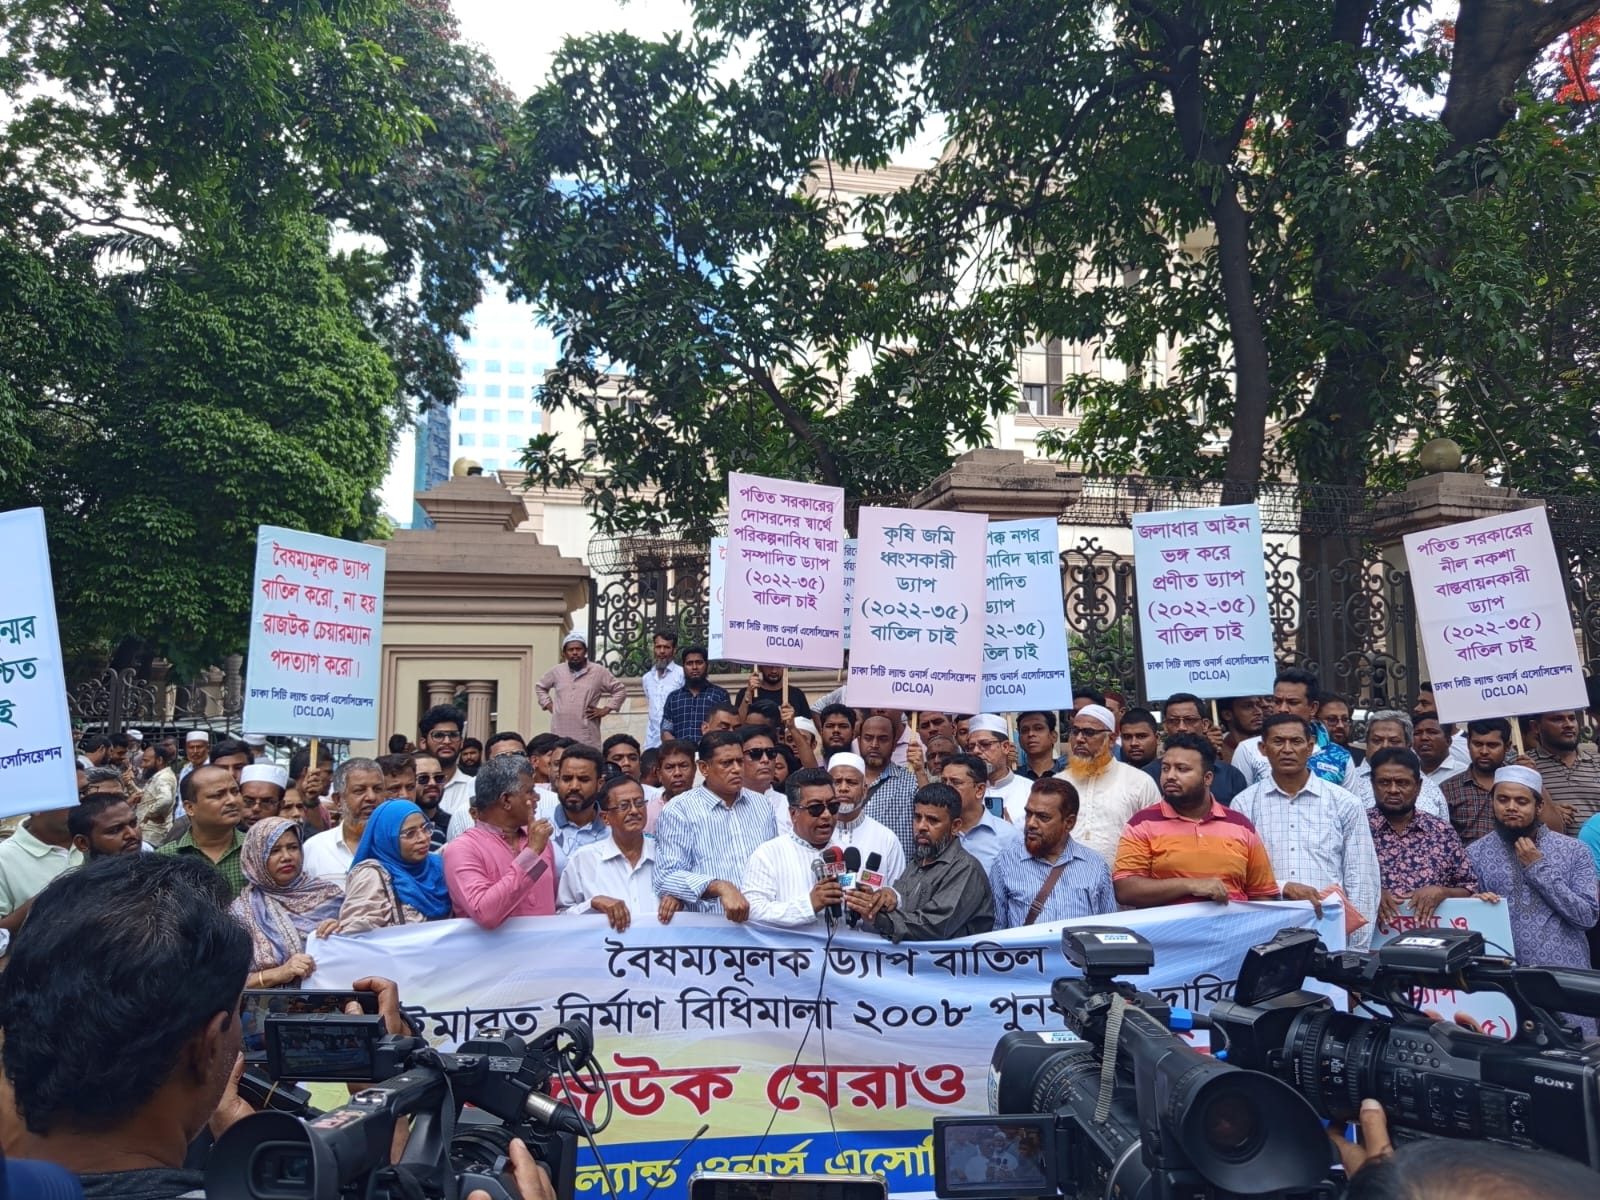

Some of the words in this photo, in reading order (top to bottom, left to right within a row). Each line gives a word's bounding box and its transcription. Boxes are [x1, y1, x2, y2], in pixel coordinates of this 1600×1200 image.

[740, 486, 776, 504] পতিত
[780, 493, 834, 514] সরকারের
[741, 508, 800, 528] দোসরদের
[804, 516, 833, 533] স্বার্থে
[1136, 521, 1199, 540] জলাধার
[1204, 514, 1252, 535] আইন
[733, 526, 810, 550] পরিকল্পনাবিধ
[814, 538, 839, 553] দ্বারা
[882, 522, 916, 548] কৃষি
[921, 525, 956, 545] জমি
[1009, 528, 1040, 544] নগর
[1417, 537, 1460, 557] পতিত
[1464, 522, 1534, 546] সরকারের
[273, 541, 338, 579] বৈষম্যমূলক
[342, 559, 371, 580] ড্যাপ
[741, 548, 797, 567] সম্পাদিত
[800, 556, 831, 572] ড্যাপ
[880, 549, 957, 570] ধ্বংসকারী
[1024, 550, 1054, 566] দ্বারা
[1160, 548, 1190, 563] ভঙ্গ
[1195, 543, 1231, 561] করে
[1439, 557, 1469, 575] নীল
[1472, 547, 1517, 569] নকশা
[745, 568, 825, 594] (২০২২-৩৫)
[896, 576, 937, 593] ড্যাপ
[1152, 569, 1199, 592] প্রণীত
[1203, 569, 1246, 588] ড্যাপ
[1434, 564, 1531, 598] বাস্তবায়নকারী
[261, 574, 301, 602] বাতিল
[343, 591, 357, 611] না
[360, 593, 377, 615] হয়
[752, 588, 792, 608] বাতিল
[795, 593, 818, 610] চাই
[1467, 595, 1505, 614] ড্যাপ
[861, 598, 969, 624] (২০২২-৩৫)
[1148, 595, 1256, 623] (২০২২-৩৫)
[262, 610, 311, 639] রাজউক
[313, 621, 372, 647] চেয়ারম্যান
[729, 620, 745, 630] ঢাকা
[747, 620, 761, 632] সিটি
[800, 626, 839, 639] এসোসিয়েশন
[870, 621, 922, 643] বাতিল
[928, 625, 959, 646] চাই
[1155, 622, 1209, 645] বাতিল
[1212, 620, 1245, 641] চাই
[1443, 612, 1542, 644] (২০২২-৩৫)
[766, 637, 803, 650] (DCLOA)
[1012, 641, 1039, 660] চাই
[1456, 641, 1503, 662] বাতিল
[1506, 635, 1538, 653] চাই
[270, 649, 321, 674] পদত্যাগ
[851, 666, 868, 676] ঢাকা
[870, 665, 886, 677] সিটি
[908, 668, 929, 680] ওনার্স
[930, 670, 976, 682] এসোসিয়েশন
[1021, 668, 1065, 680] এসোসিয়েশন
[1147, 661, 1164, 671] ঢাকা
[1165, 657, 1181, 670] সিটি
[1203, 655, 1223, 667] ওনার্স
[1224, 654, 1270, 666] এসোসিয়েশন
[891, 680, 934, 696] (DCLOA)
[1188, 670, 1230, 684] (DCLOA)
[1434, 680, 1453, 692] ঢাকা
[1454, 676, 1471, 689] সিটি
[1496, 669, 1519, 683] ওনার্স
[1520, 664, 1573, 680] এসোসিয়েশন
[250, 688, 269, 699] ঢাকা
[271, 687, 288, 700] সিটি
[331, 695, 374, 708] এসোসিয়েশন
[985, 684, 1026, 697] (DCLOA)
[1481, 683, 1529, 701] (DCLOA)
[293, 705, 335, 720] (DCLOA)
[605, 937, 814, 986] বৈষম্যমূলক
[828, 944, 919, 979] ড্যাপ
[933, 941, 1050, 977] বাতিল
[552, 989, 665, 1034] নির্মাণ
[678, 986, 837, 1033] বিধিমালা
[852, 999, 972, 1034] ২০০৮
[767, 1061, 966, 1111] ঘেরাও
[1534, 1075, 1575, 1090] SONY
[575, 1159, 681, 1195] ল্যান্ড
